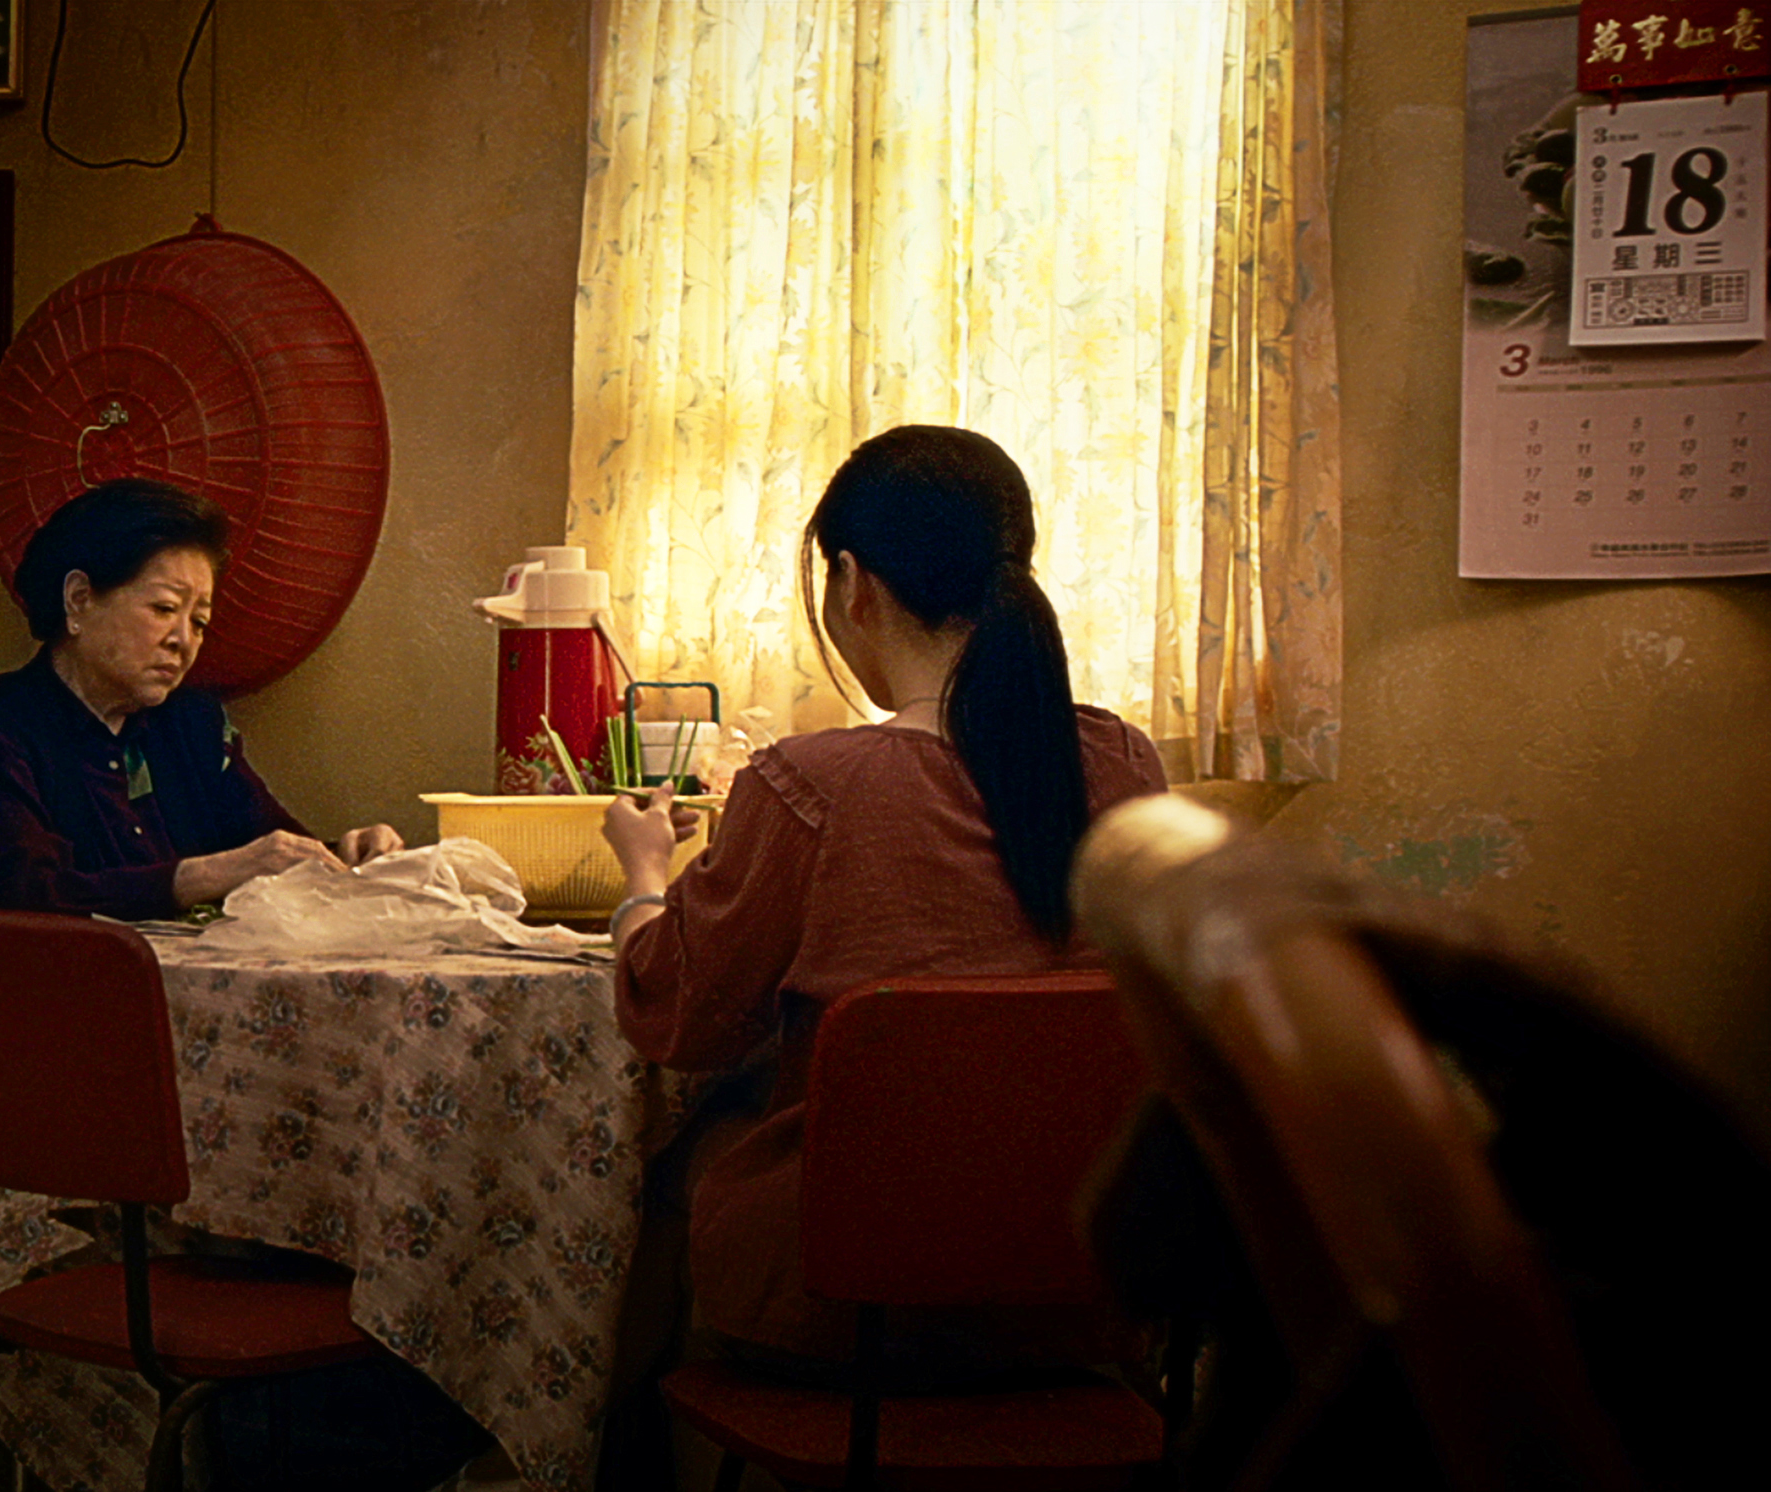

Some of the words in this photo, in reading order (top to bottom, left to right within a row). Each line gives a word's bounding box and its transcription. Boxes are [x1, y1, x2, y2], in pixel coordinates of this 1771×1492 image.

[1585, 7, 1765, 64] 萬事如意
[1612, 147, 1728, 237] 18
[1612, 242, 1723, 270] 星期三
[1499, 344, 1531, 378] 3
